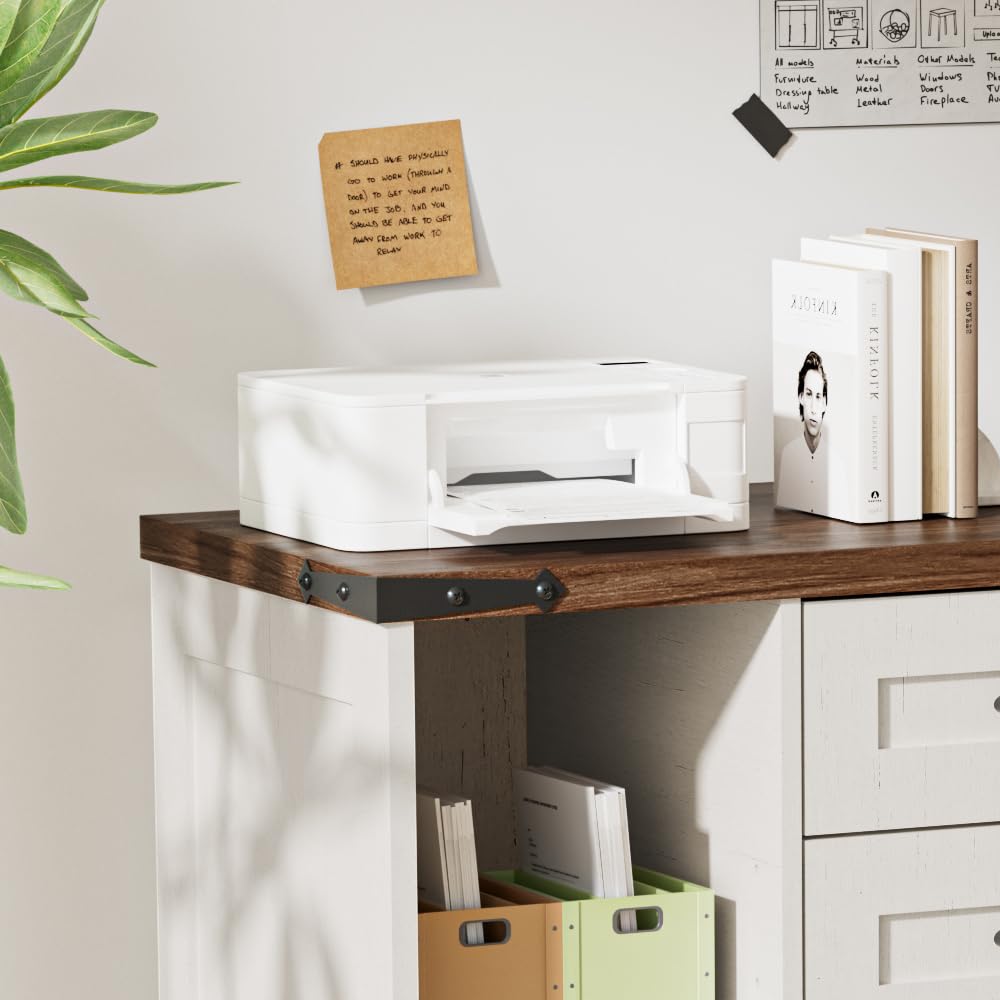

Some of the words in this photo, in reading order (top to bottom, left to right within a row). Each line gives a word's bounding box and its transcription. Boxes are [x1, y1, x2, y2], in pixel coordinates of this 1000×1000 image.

[775, 57, 784, 67] All
[787, 57, 814, 67] models
[856, 54, 900, 65] Materials
[917, 54, 942, 64] Other
[947, 54, 976, 63] Models
[774, 73, 817, 84] Furniture
[856, 74, 879, 82] Wood
[920, 72, 962, 82] Windows
[855, 84, 883, 94] Metal
[920, 84, 944, 93] Doors
[986, 84, 1000, 93] TV
[775, 88, 812, 105] Dressing
[817, 85, 839, 95] table
[857, 97, 893, 108] Leather
[920, 94, 969, 108] Fireplace
[776, 102, 810, 115] Hallway
[350, 157, 379, 168] SHOULD
[384, 155, 403, 164] HAVE
[408, 149, 449, 161] PHYSICALLY
[347, 177, 361, 185] GO
[367, 176, 376, 184] TO
[382, 174, 402, 182] WORK
[373, 191, 382, 199] TO
[388, 190, 403, 198] GET
[408, 187, 426, 196] YOUR
[430, 183, 451, 193] MIND
[363, 206, 379, 214] THE
[411, 202, 427, 212] AND
[431, 201, 446, 210] YOU
[350, 220, 379, 230] SHOULD
[382, 219, 393, 227] BE
[399, 217, 418, 226] ABLE
[423, 217, 433, 225] TO
[436, 214, 453, 223] GET
[352, 236, 374, 245] AWAY
[377, 235, 398, 244] FROM
[403, 232, 426, 241] WORK
[431, 229, 442, 238] TO
